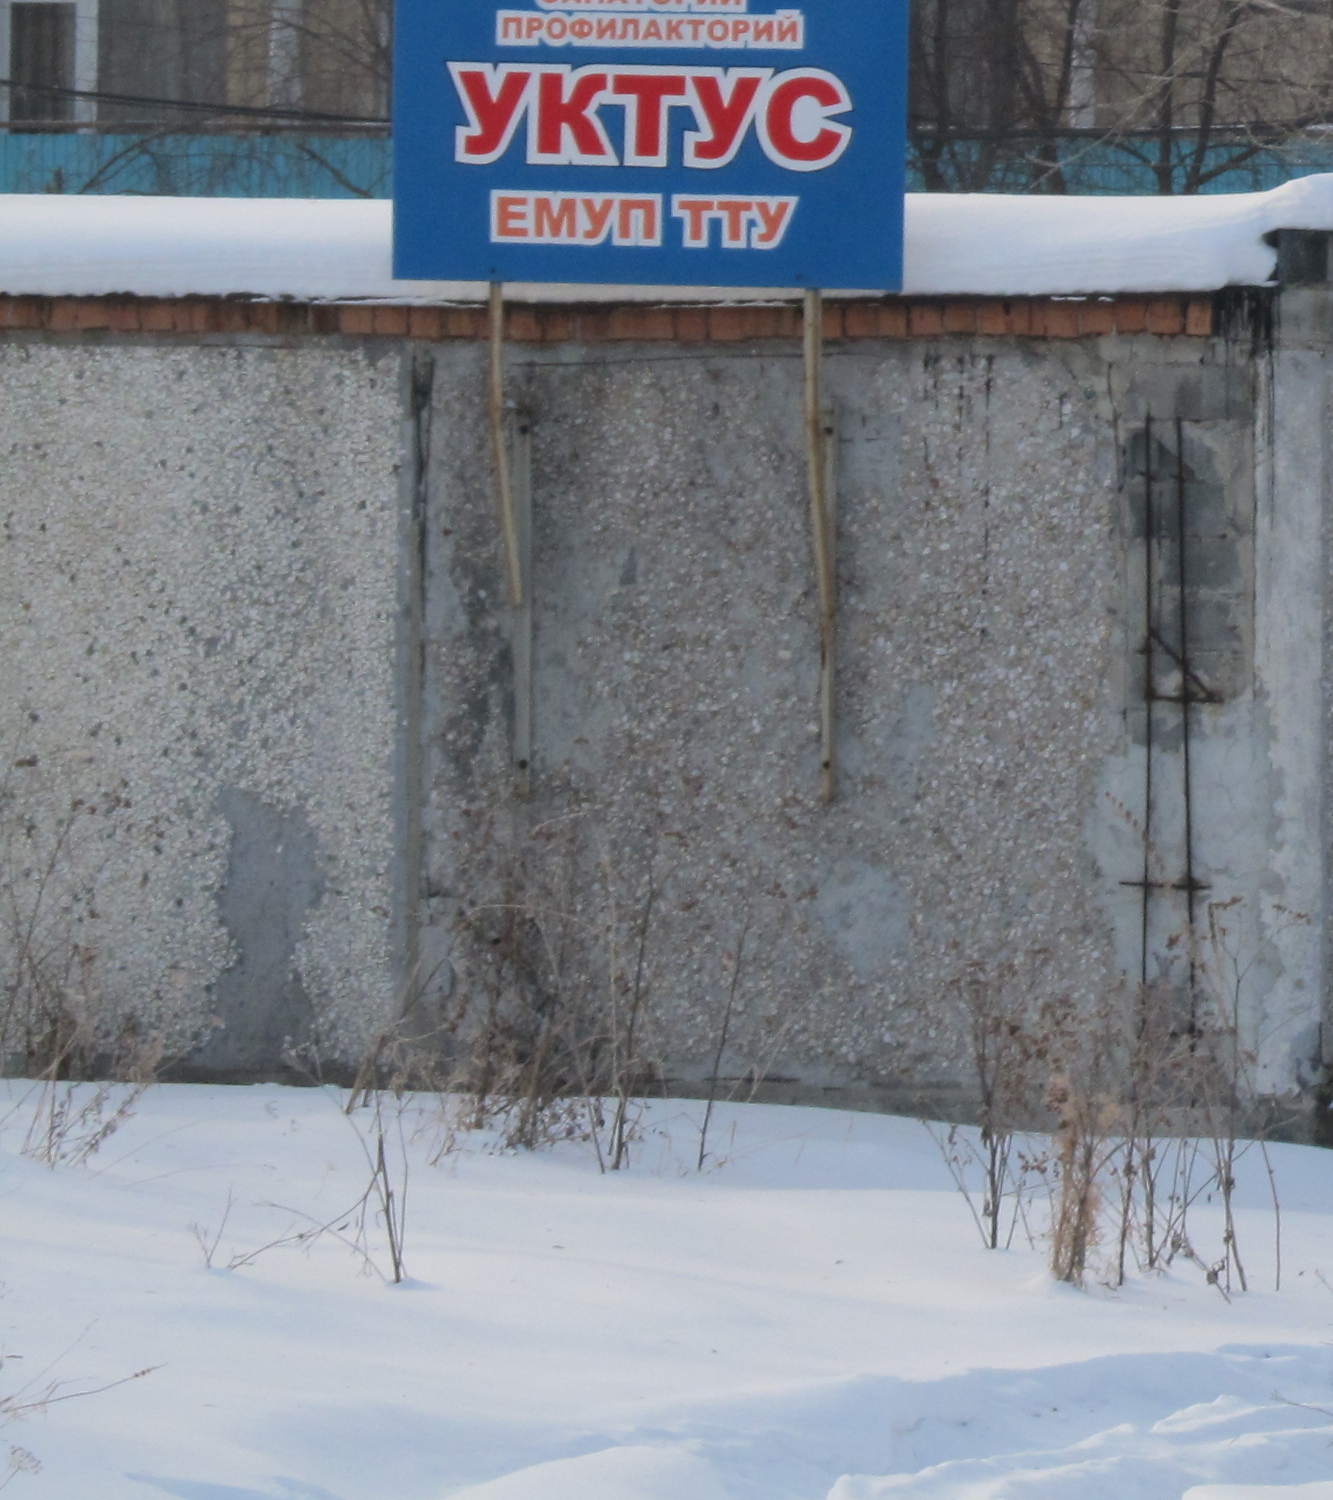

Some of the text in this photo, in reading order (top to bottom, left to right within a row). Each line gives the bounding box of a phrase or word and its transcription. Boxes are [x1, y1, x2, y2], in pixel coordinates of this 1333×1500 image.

[501, 14, 799, 44] ПРОФИЛАКТОРИЙ
[456, 68, 844, 163] УКТУС
[494, 194, 791, 244] ЕМУП ТТУ
